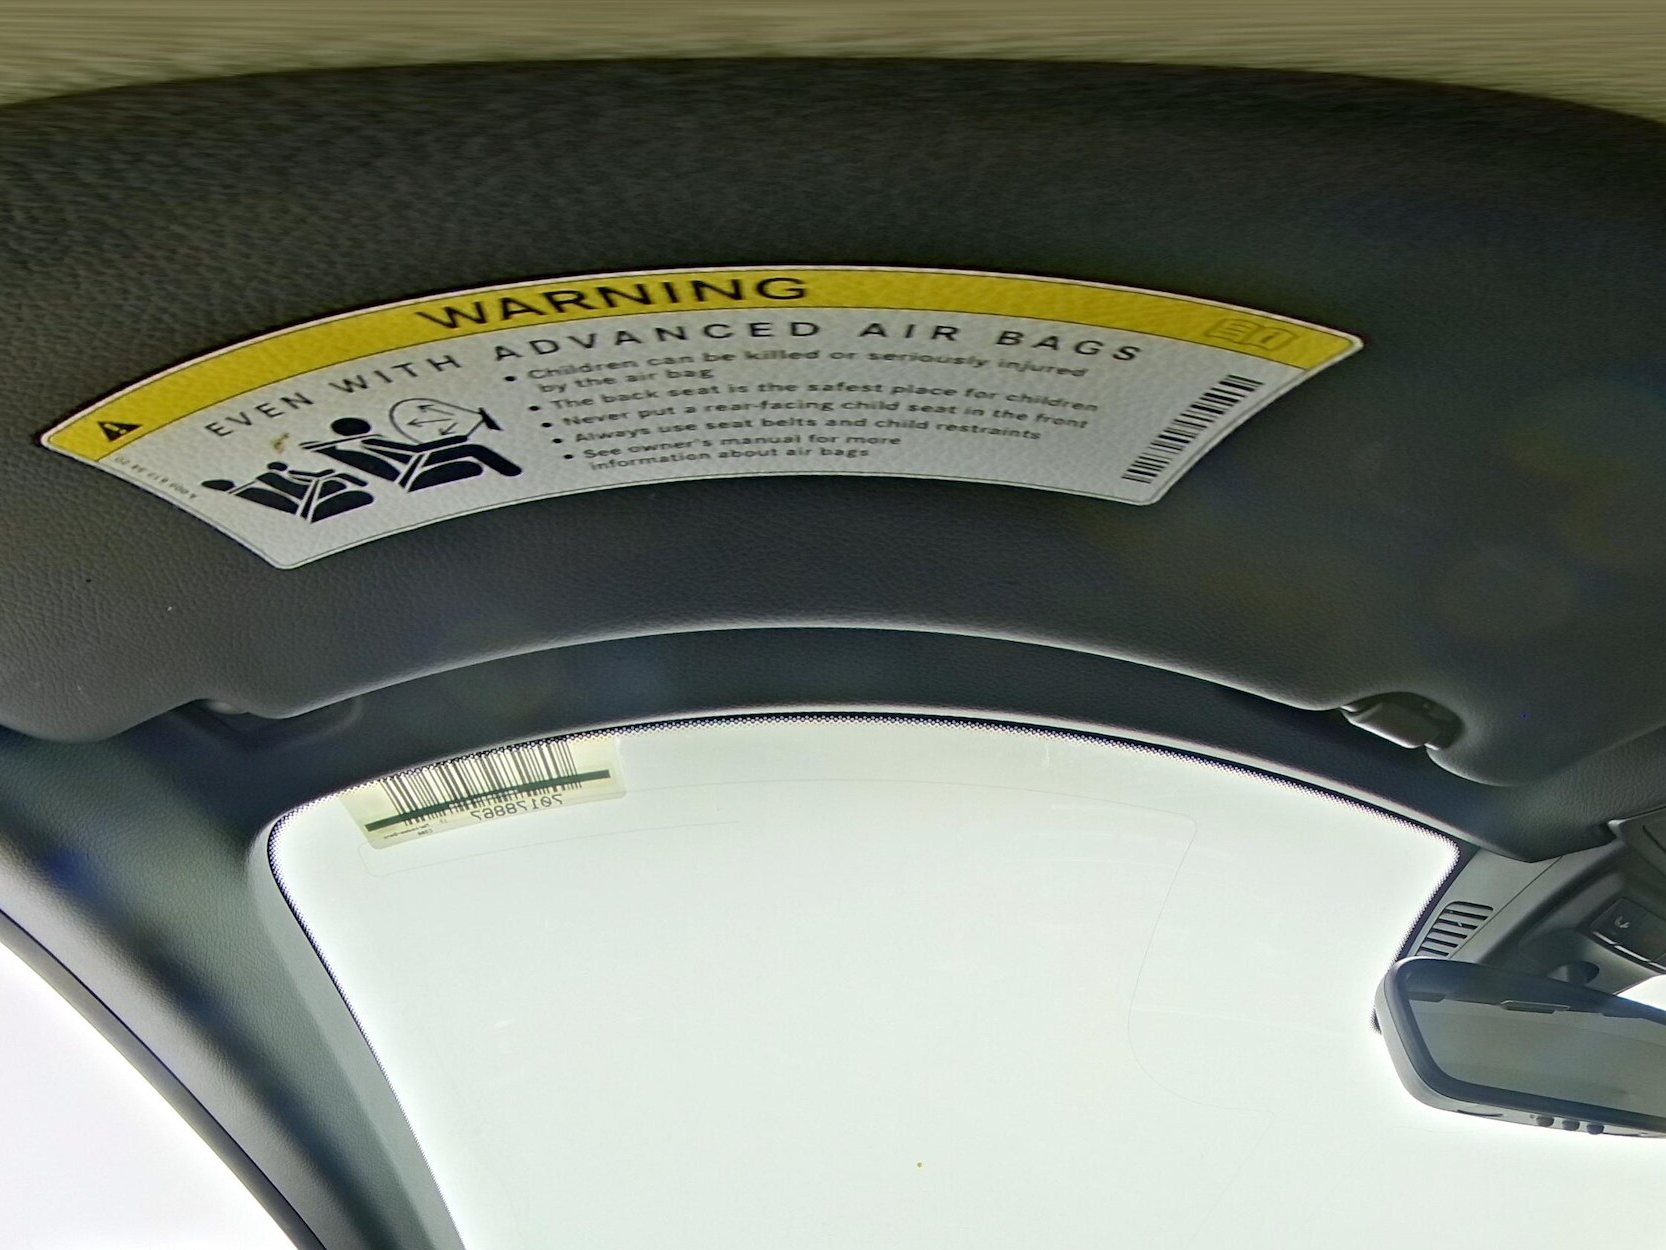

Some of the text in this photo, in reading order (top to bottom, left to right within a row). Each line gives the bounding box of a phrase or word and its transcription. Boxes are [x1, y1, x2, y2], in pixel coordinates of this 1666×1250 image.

[415, 277, 808, 329] WARNING
[204, 321, 1141, 437] EVEN WITH ADVANCED AIR BAGS
[527, 349, 1089, 380] Children can be killed or seriously injured
[538, 368, 715, 393] by the air bag
[550, 381, 1099, 412] The back seat is the safest place for children
[562, 400, 1089, 429] Never put a rear-facing child seat in the front
[575, 417, 1042, 442] Always use seat belts and child restraints
[583, 434, 902, 459] See owner's manual for more
[589, 447, 870, 471] information about air bags
